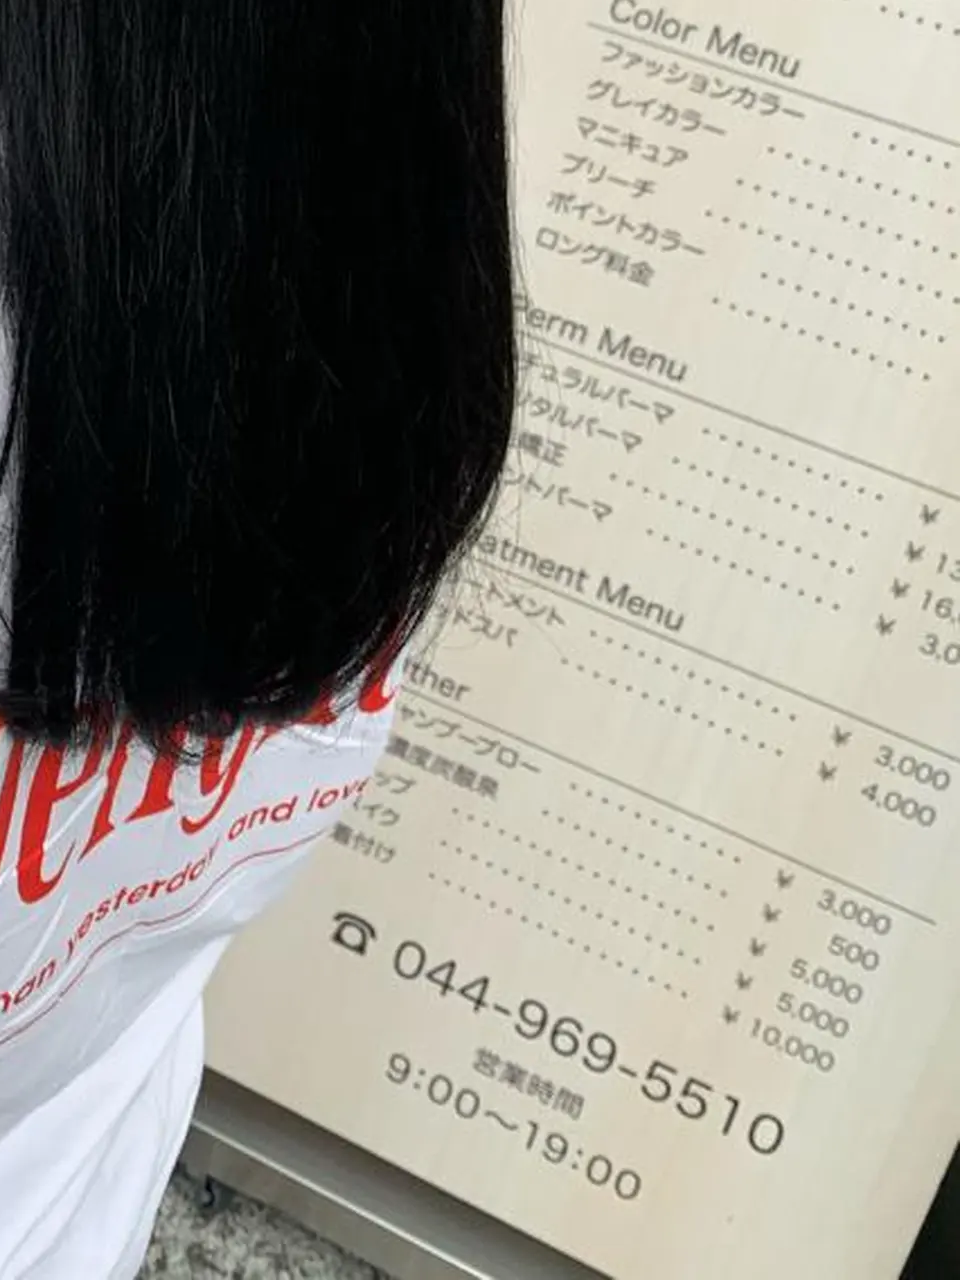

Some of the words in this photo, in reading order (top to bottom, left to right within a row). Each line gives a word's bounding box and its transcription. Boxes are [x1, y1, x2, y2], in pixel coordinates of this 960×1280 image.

[600, 41, 806, 120] ファッションカラー
[706, 25, 802, 80] Menu
[586, 78, 727, 137] グレイカラー
[577, 115, 689, 167] マニキュア
[546, 190, 706, 257] ポイントカラー
[536, 226, 656, 288] ロング料金
[597, 327, 688, 382] Menu
[478, 534, 591, 593] atment
[596, 576, 686, 633] Menu
[405, 658, 472, 702] ther
[227, 794, 298, 841] and
[826, 933, 881, 972] 500
[393, 940, 785, 1156] 044-969-5510
[472, 1046, 587, 1121] 営業時間
